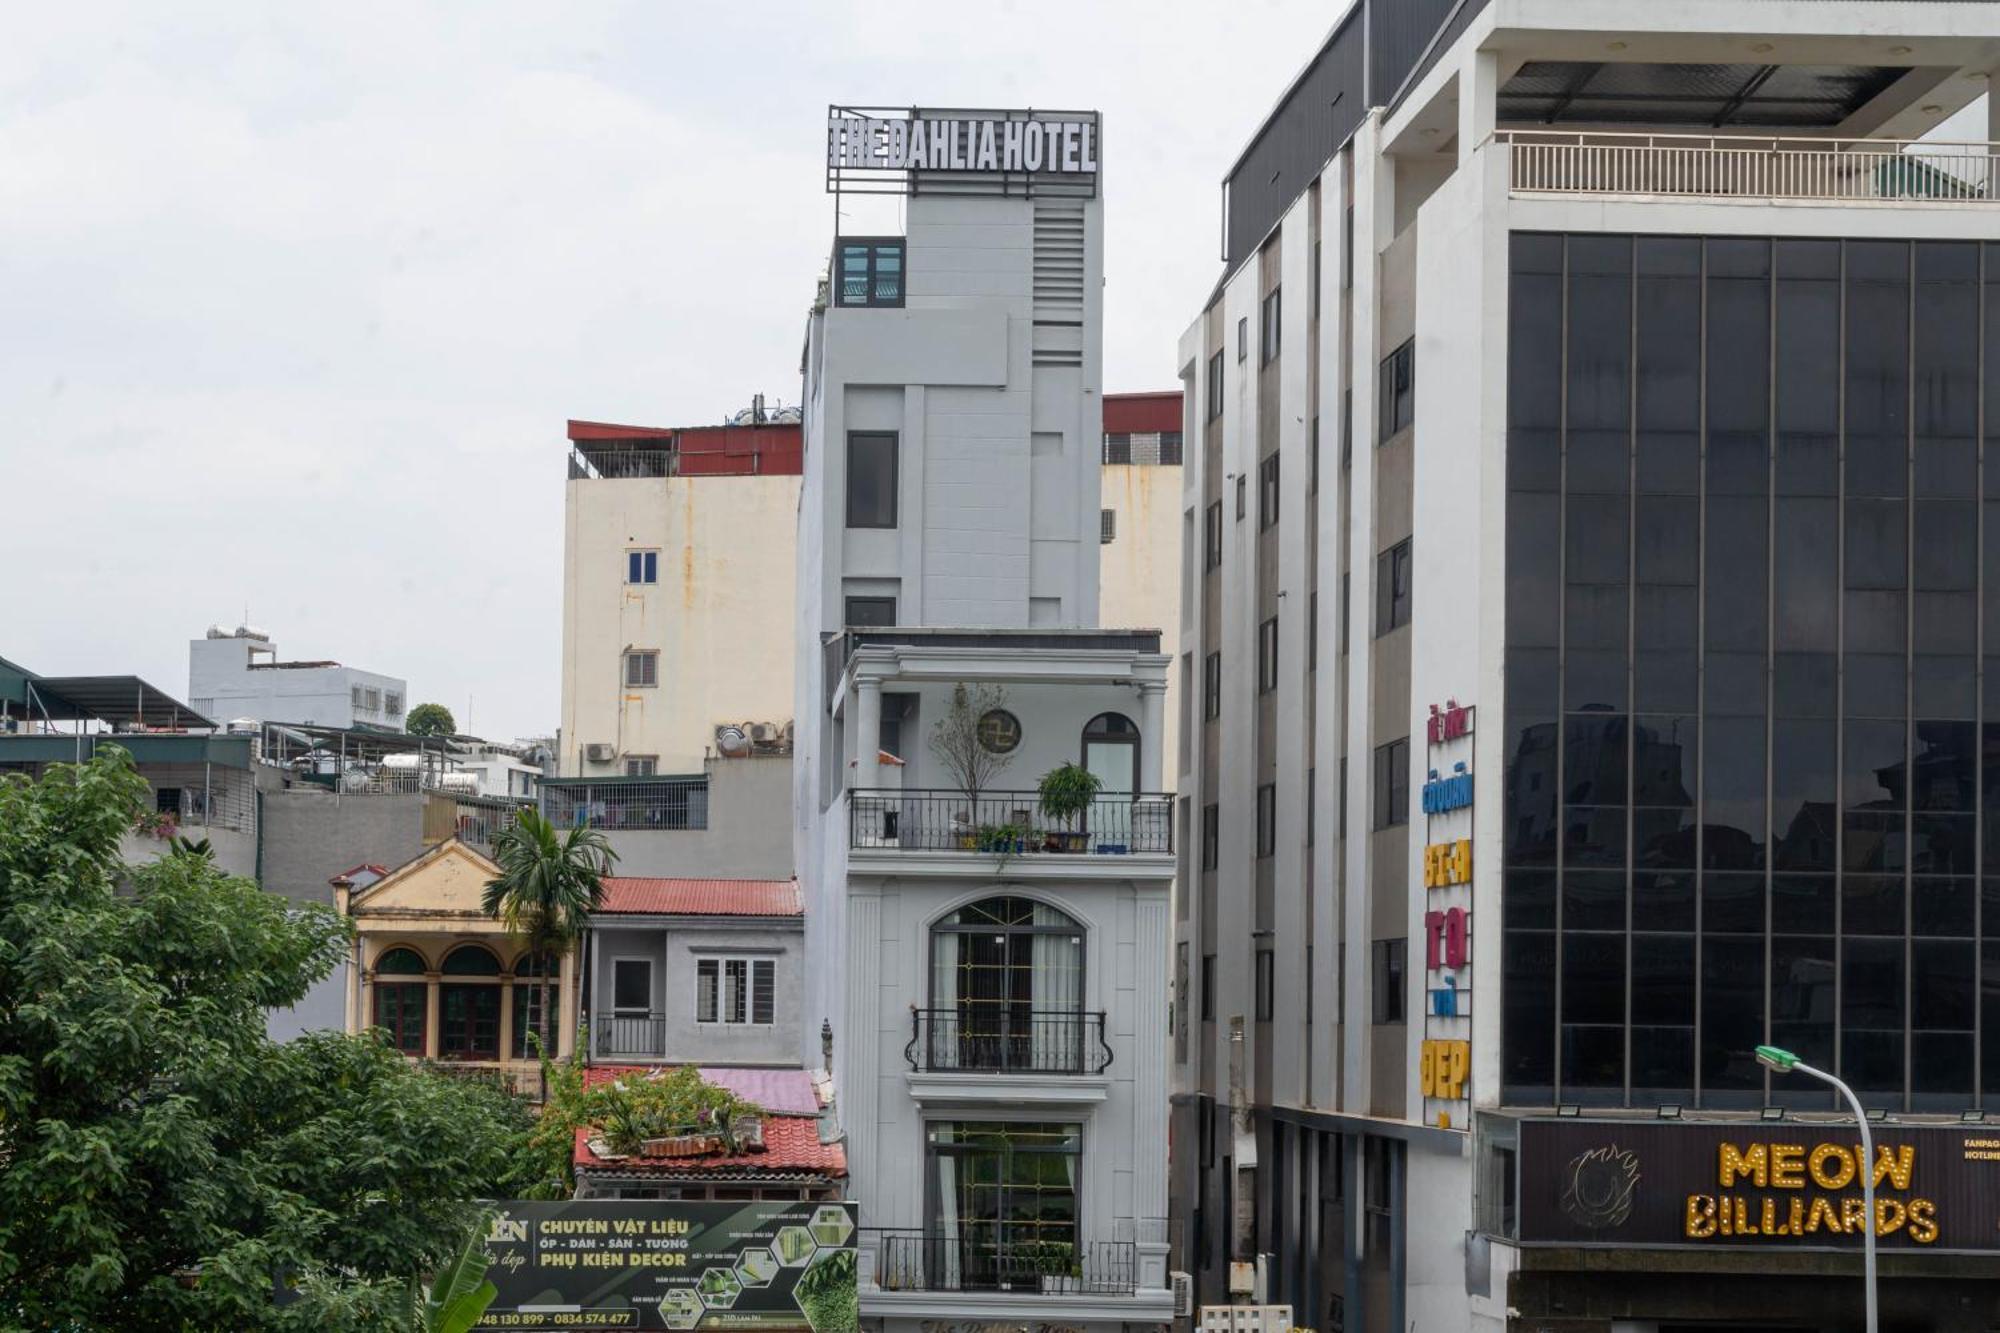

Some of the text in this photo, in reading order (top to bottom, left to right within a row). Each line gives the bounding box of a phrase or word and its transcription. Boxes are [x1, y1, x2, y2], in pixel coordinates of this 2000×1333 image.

[829, 118, 1097, 172] THE DAHLIA HOTEL
[1424, 907, 1467, 970] TO
[1719, 1142, 1915, 1190] MEOW
[540, 1218, 689, 1237] CHUYÊN VẬT LIỆU
[1685, 1194, 1940, 1244] BILLIARDS
[541, 1251, 687, 1270] PHỤ KIỆN DECOR
[500, 1314, 520, 1325] 130
[522, 1313, 544, 1325] 899
[554, 1313, 583, 1325] 0834
[609, 1313, 631, 1325] 477
